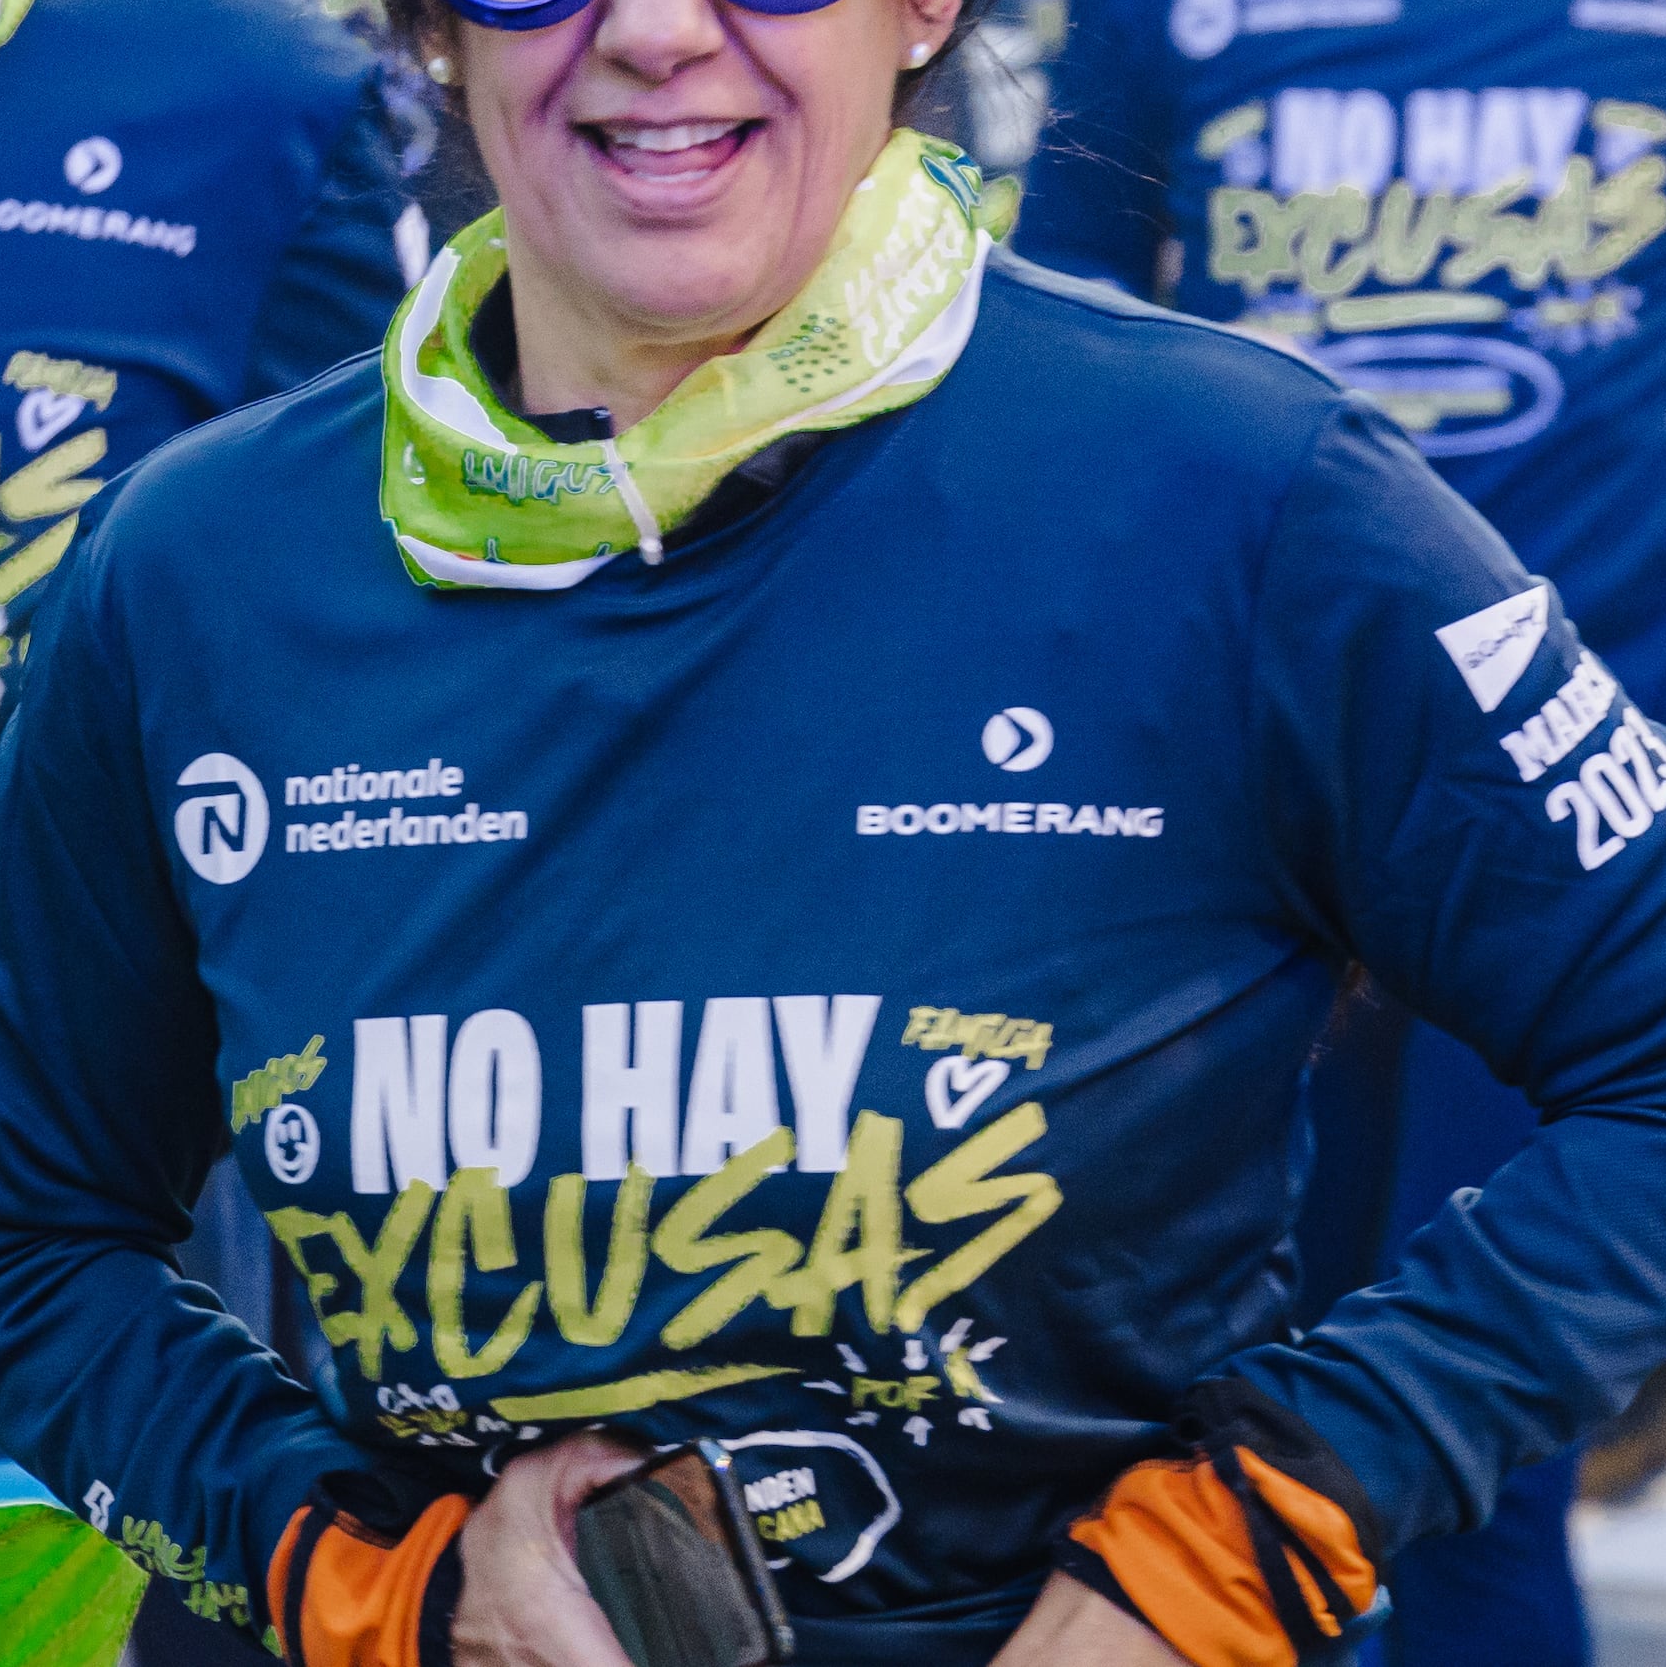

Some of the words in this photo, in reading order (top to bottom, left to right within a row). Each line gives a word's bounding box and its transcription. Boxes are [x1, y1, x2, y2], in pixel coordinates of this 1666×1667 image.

[285, 757, 465, 807] nationale
[284, 802, 529, 854] nederlanden
[855, 801, 1166, 839] BOOMERANG
[350, 1006, 544, 1197] NO
[580, 993, 884, 1184] HAY
[263, 1100, 1065, 1382] EXCUSAS
